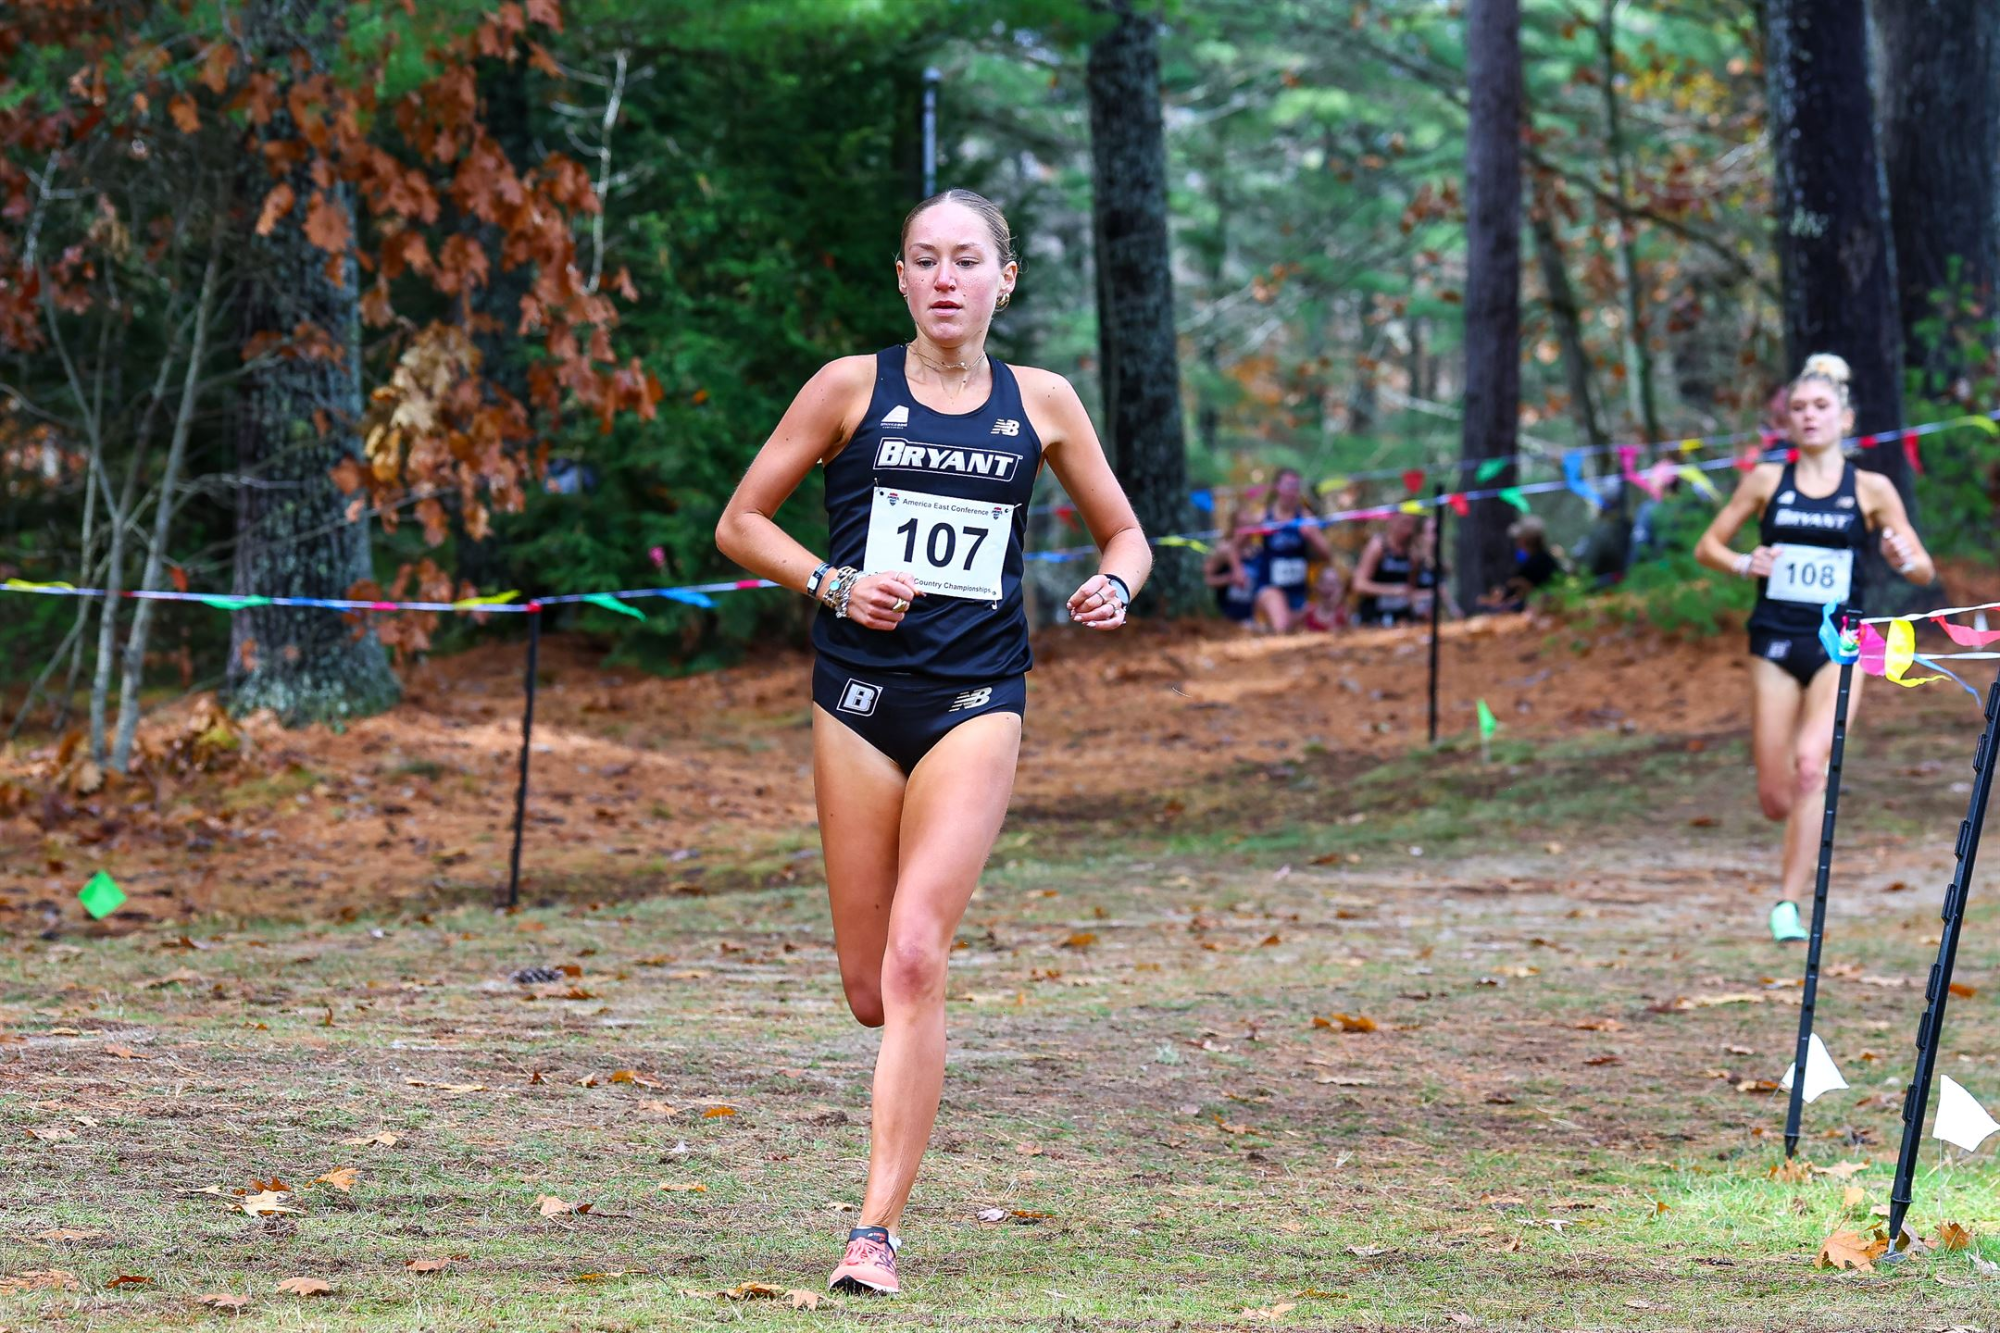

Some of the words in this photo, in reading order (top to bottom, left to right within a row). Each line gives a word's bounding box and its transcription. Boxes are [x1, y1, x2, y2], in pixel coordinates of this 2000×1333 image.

[878, 441, 1013, 476] BRYANT
[903, 498, 932, 509] America
[933, 503, 949, 511] East
[951, 504, 989, 516] Conference
[896, 517, 989, 571] 107
[913, 577, 942, 589] Country
[943, 581, 991, 594] Championships
[1786, 562, 1835, 589] 108
[842, 683, 875, 712] B
